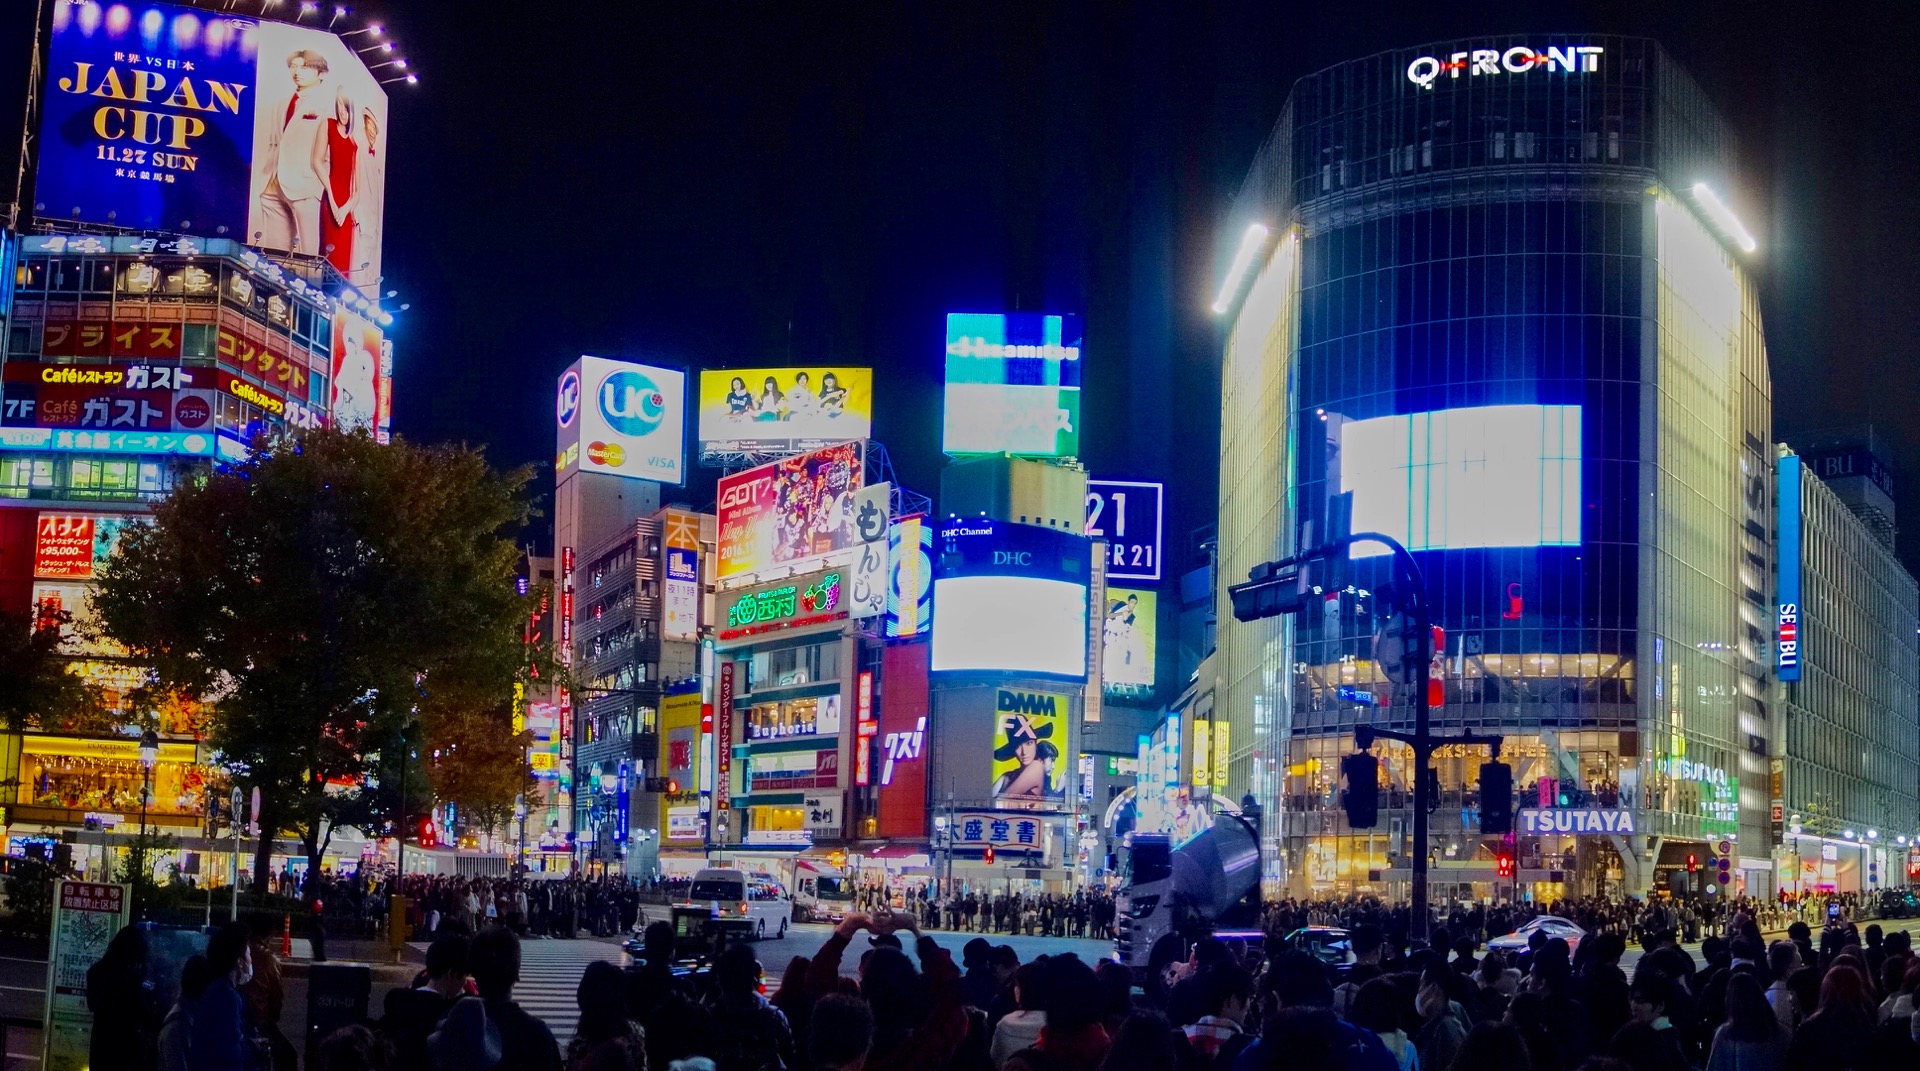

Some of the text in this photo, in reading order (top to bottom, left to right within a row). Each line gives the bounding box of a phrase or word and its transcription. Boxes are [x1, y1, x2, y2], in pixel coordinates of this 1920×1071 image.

[113, 51, 195, 72] 世界 VS 日本
[58, 62, 248, 115] JAPAN
[94, 106, 206, 150] CUP
[96, 145, 198, 172] 11.27 SUN
[46, 325, 175, 348] プライス
[218, 331, 307, 390] コンタクト
[125, 365, 192, 390] ガスト
[5, 400, 35, 418] 7F
[42, 400, 78, 415] Café
[83, 397, 163, 428] ガスト
[179, 410, 206, 419] ガスト
[605, 383, 663, 422] UC
[284, 402, 322, 430] ガスト
[587, 448, 626, 462] MasterCard
[720, 476, 771, 510] GOT7
[41, 523, 84, 537] ハワイ
[942, 527, 992, 537] DHC Channel
[993, 551, 1032, 566] DHC
[1131, 544, 1153, 567] 21
[758, 595, 795, 620] 西村
[1779, 603, 1797, 666] SEIBU
[998, 690, 1056, 717] DMM
[721, 683, 730, 763] ウィンターフルーツギフト
[752, 722, 814, 739] Euphoria
[997, 714, 1037, 739] FX
[882, 717, 926, 784] クスリ
[1374, 744, 1547, 760] TARBCKS CFFEE
[1523, 809, 1633, 832] TSUTAYA
